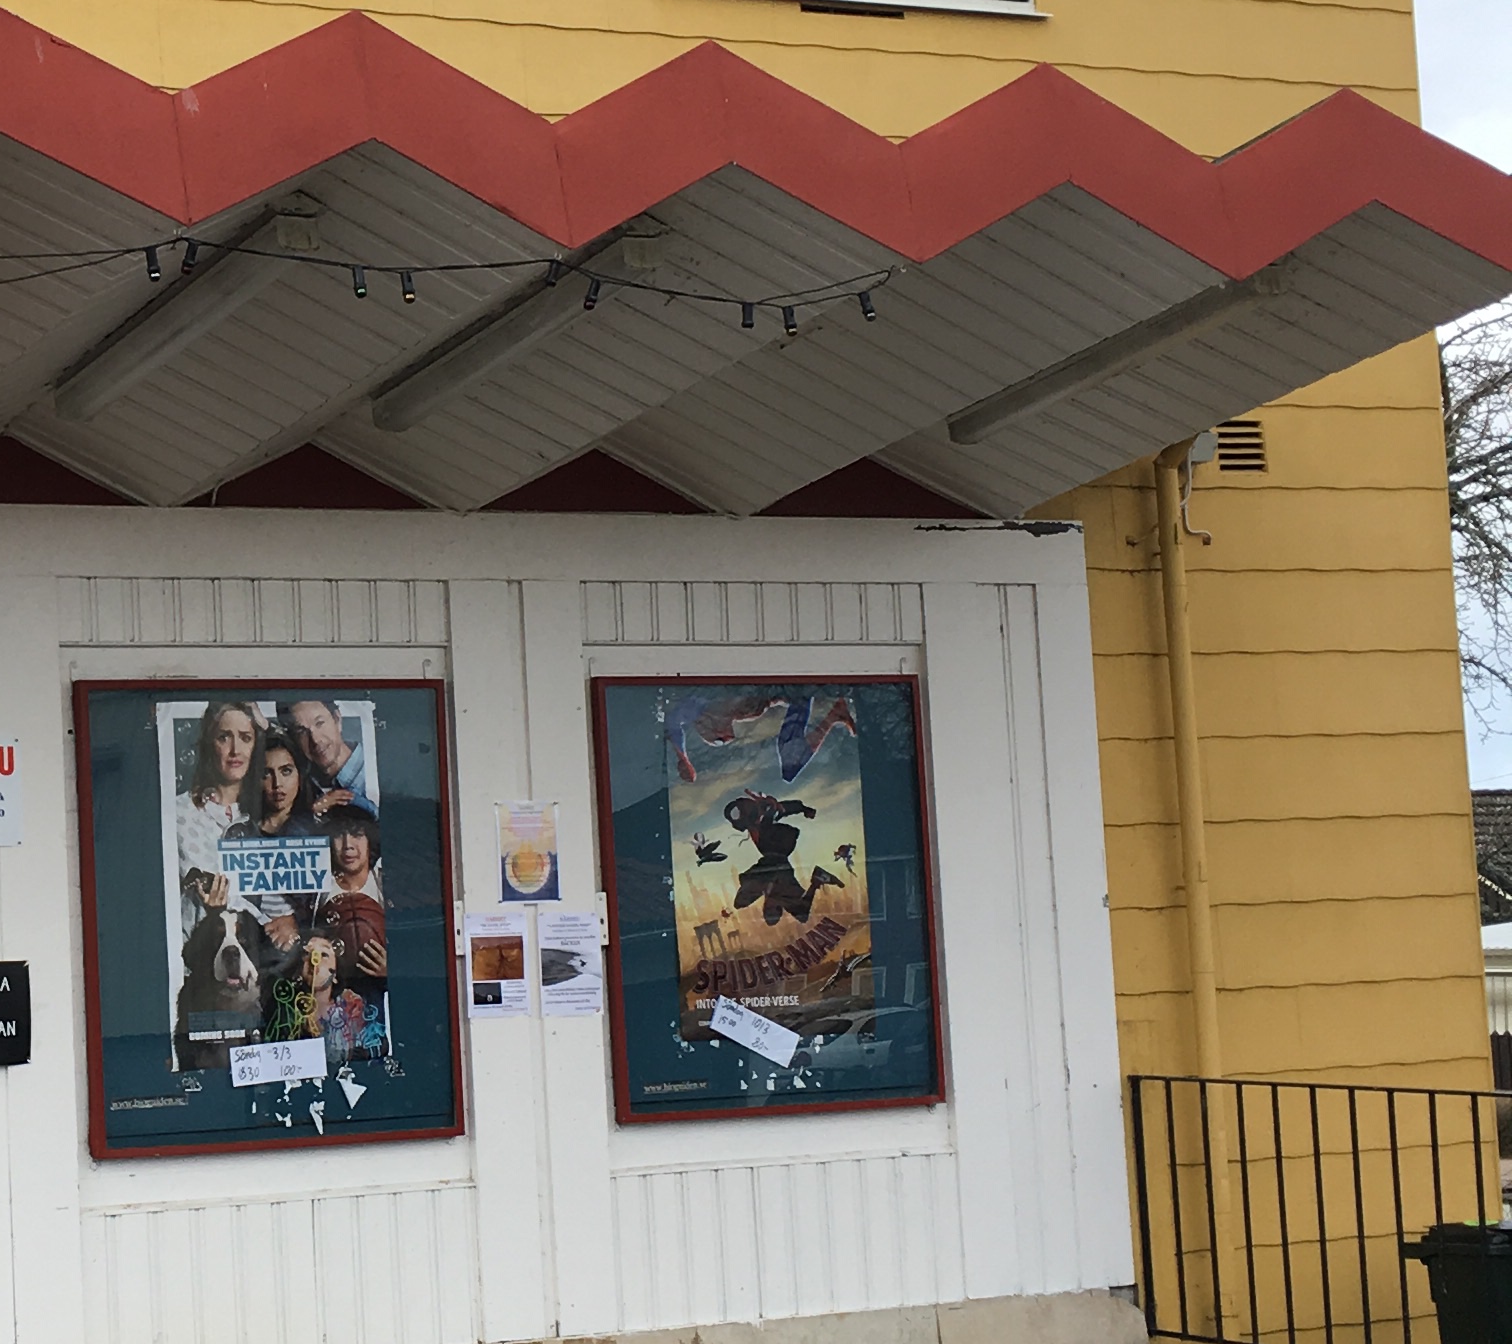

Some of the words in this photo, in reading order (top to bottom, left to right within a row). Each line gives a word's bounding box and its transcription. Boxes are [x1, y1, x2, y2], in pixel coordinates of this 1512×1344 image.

[222, 850, 320, 871] INSTANT
[238, 869, 327, 892] FAMILY
[692, 916, 848, 994] SPIDER-MAN
[695, 998, 717, 1009] INTO
